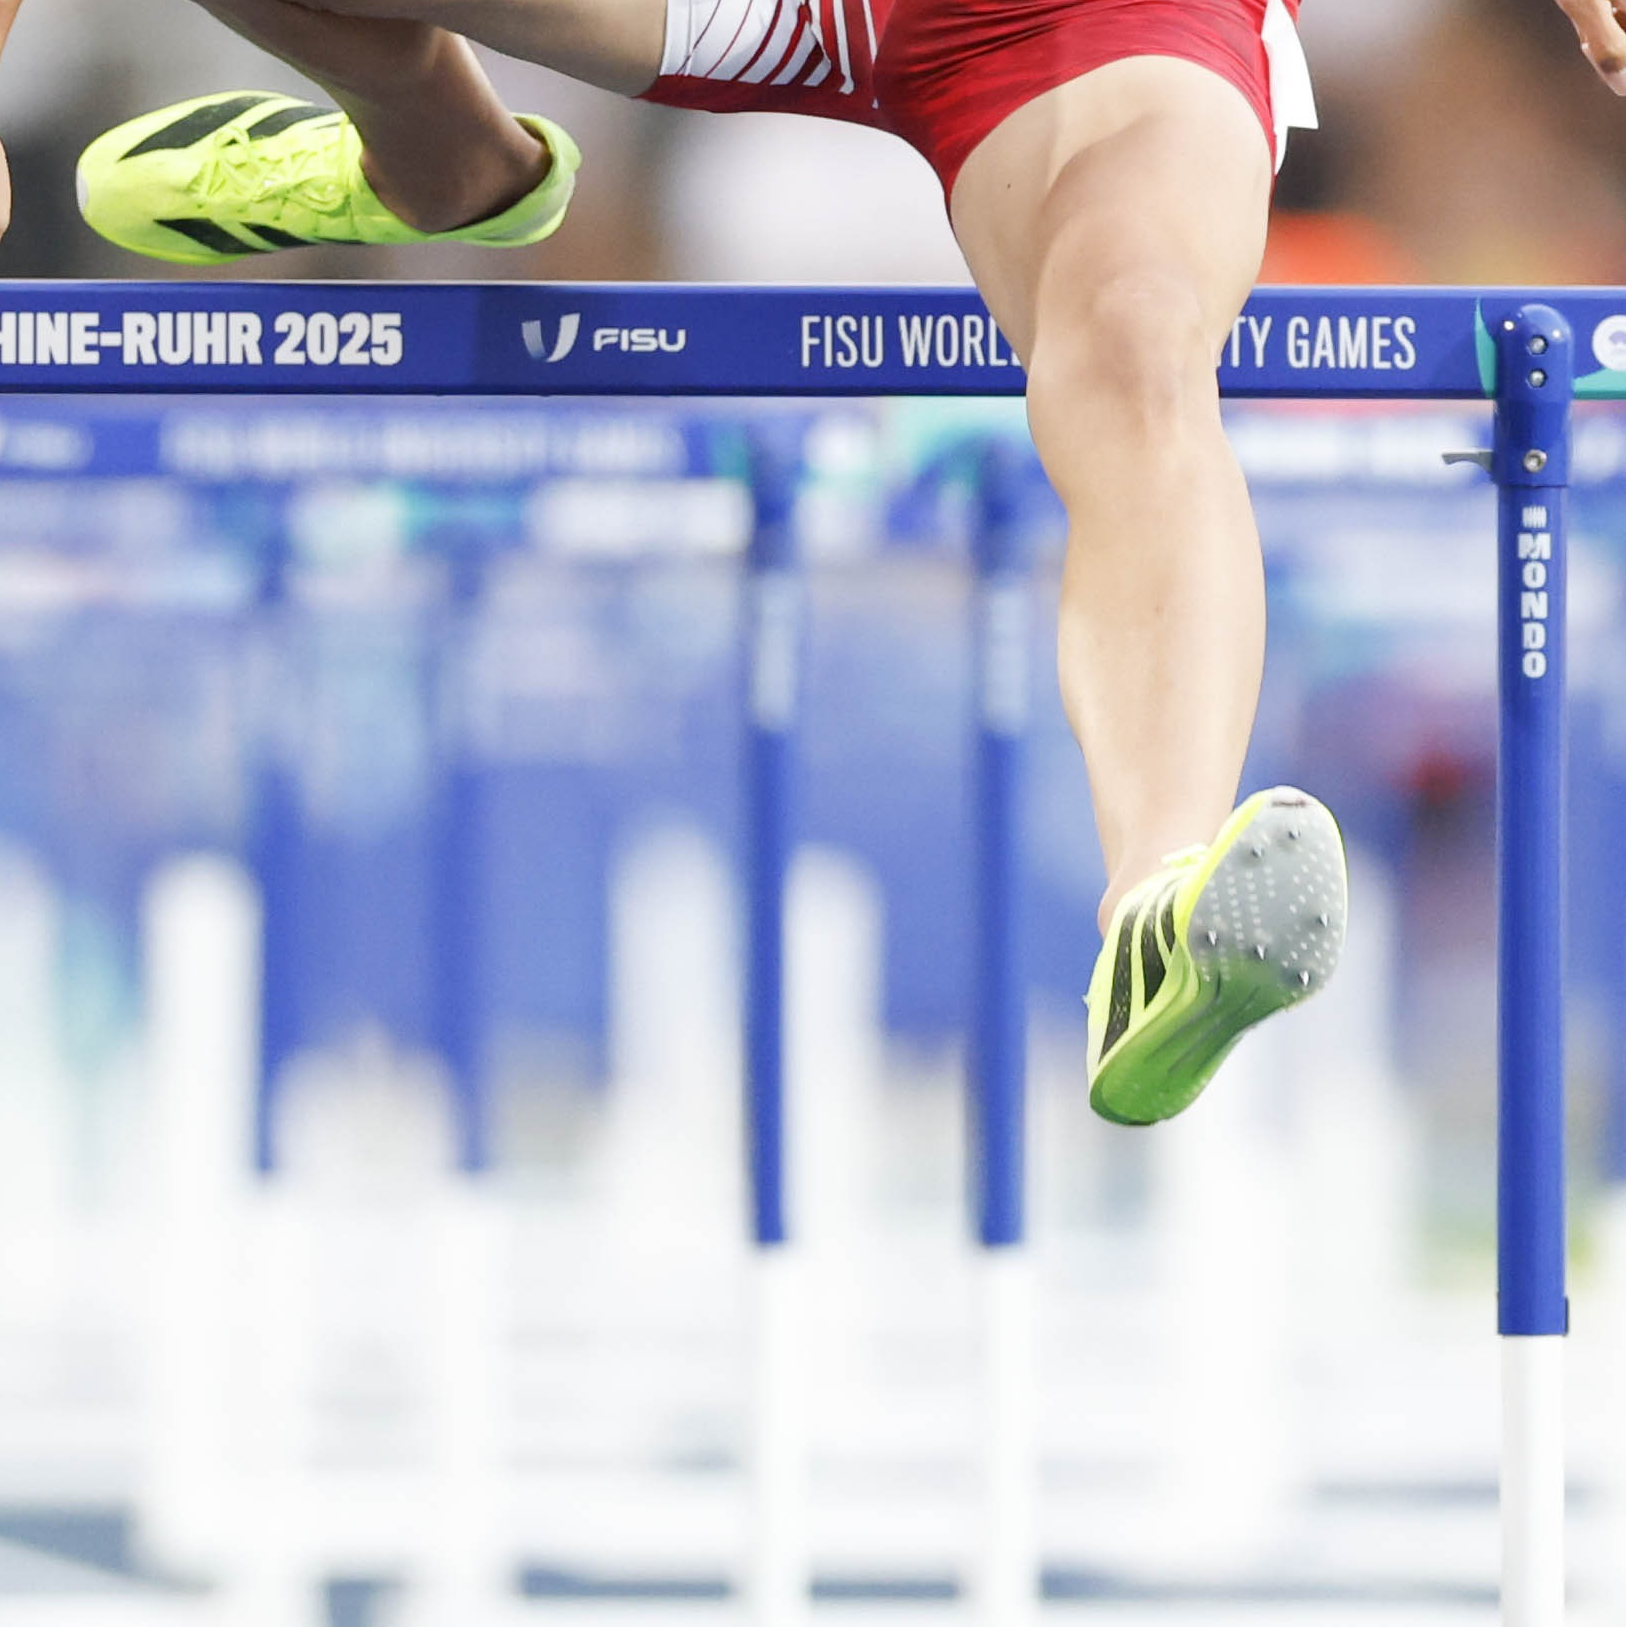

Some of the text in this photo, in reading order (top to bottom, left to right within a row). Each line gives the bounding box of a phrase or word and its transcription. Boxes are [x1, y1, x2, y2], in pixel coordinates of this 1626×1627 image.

[274, 312, 403, 366] 2025
[594, 327, 686, 352] FISU
[801, 315, 1022, 368] FISU WORL
[1287, 316, 1416, 370] GAMES
[1517, 531, 1552, 678] MONDO
